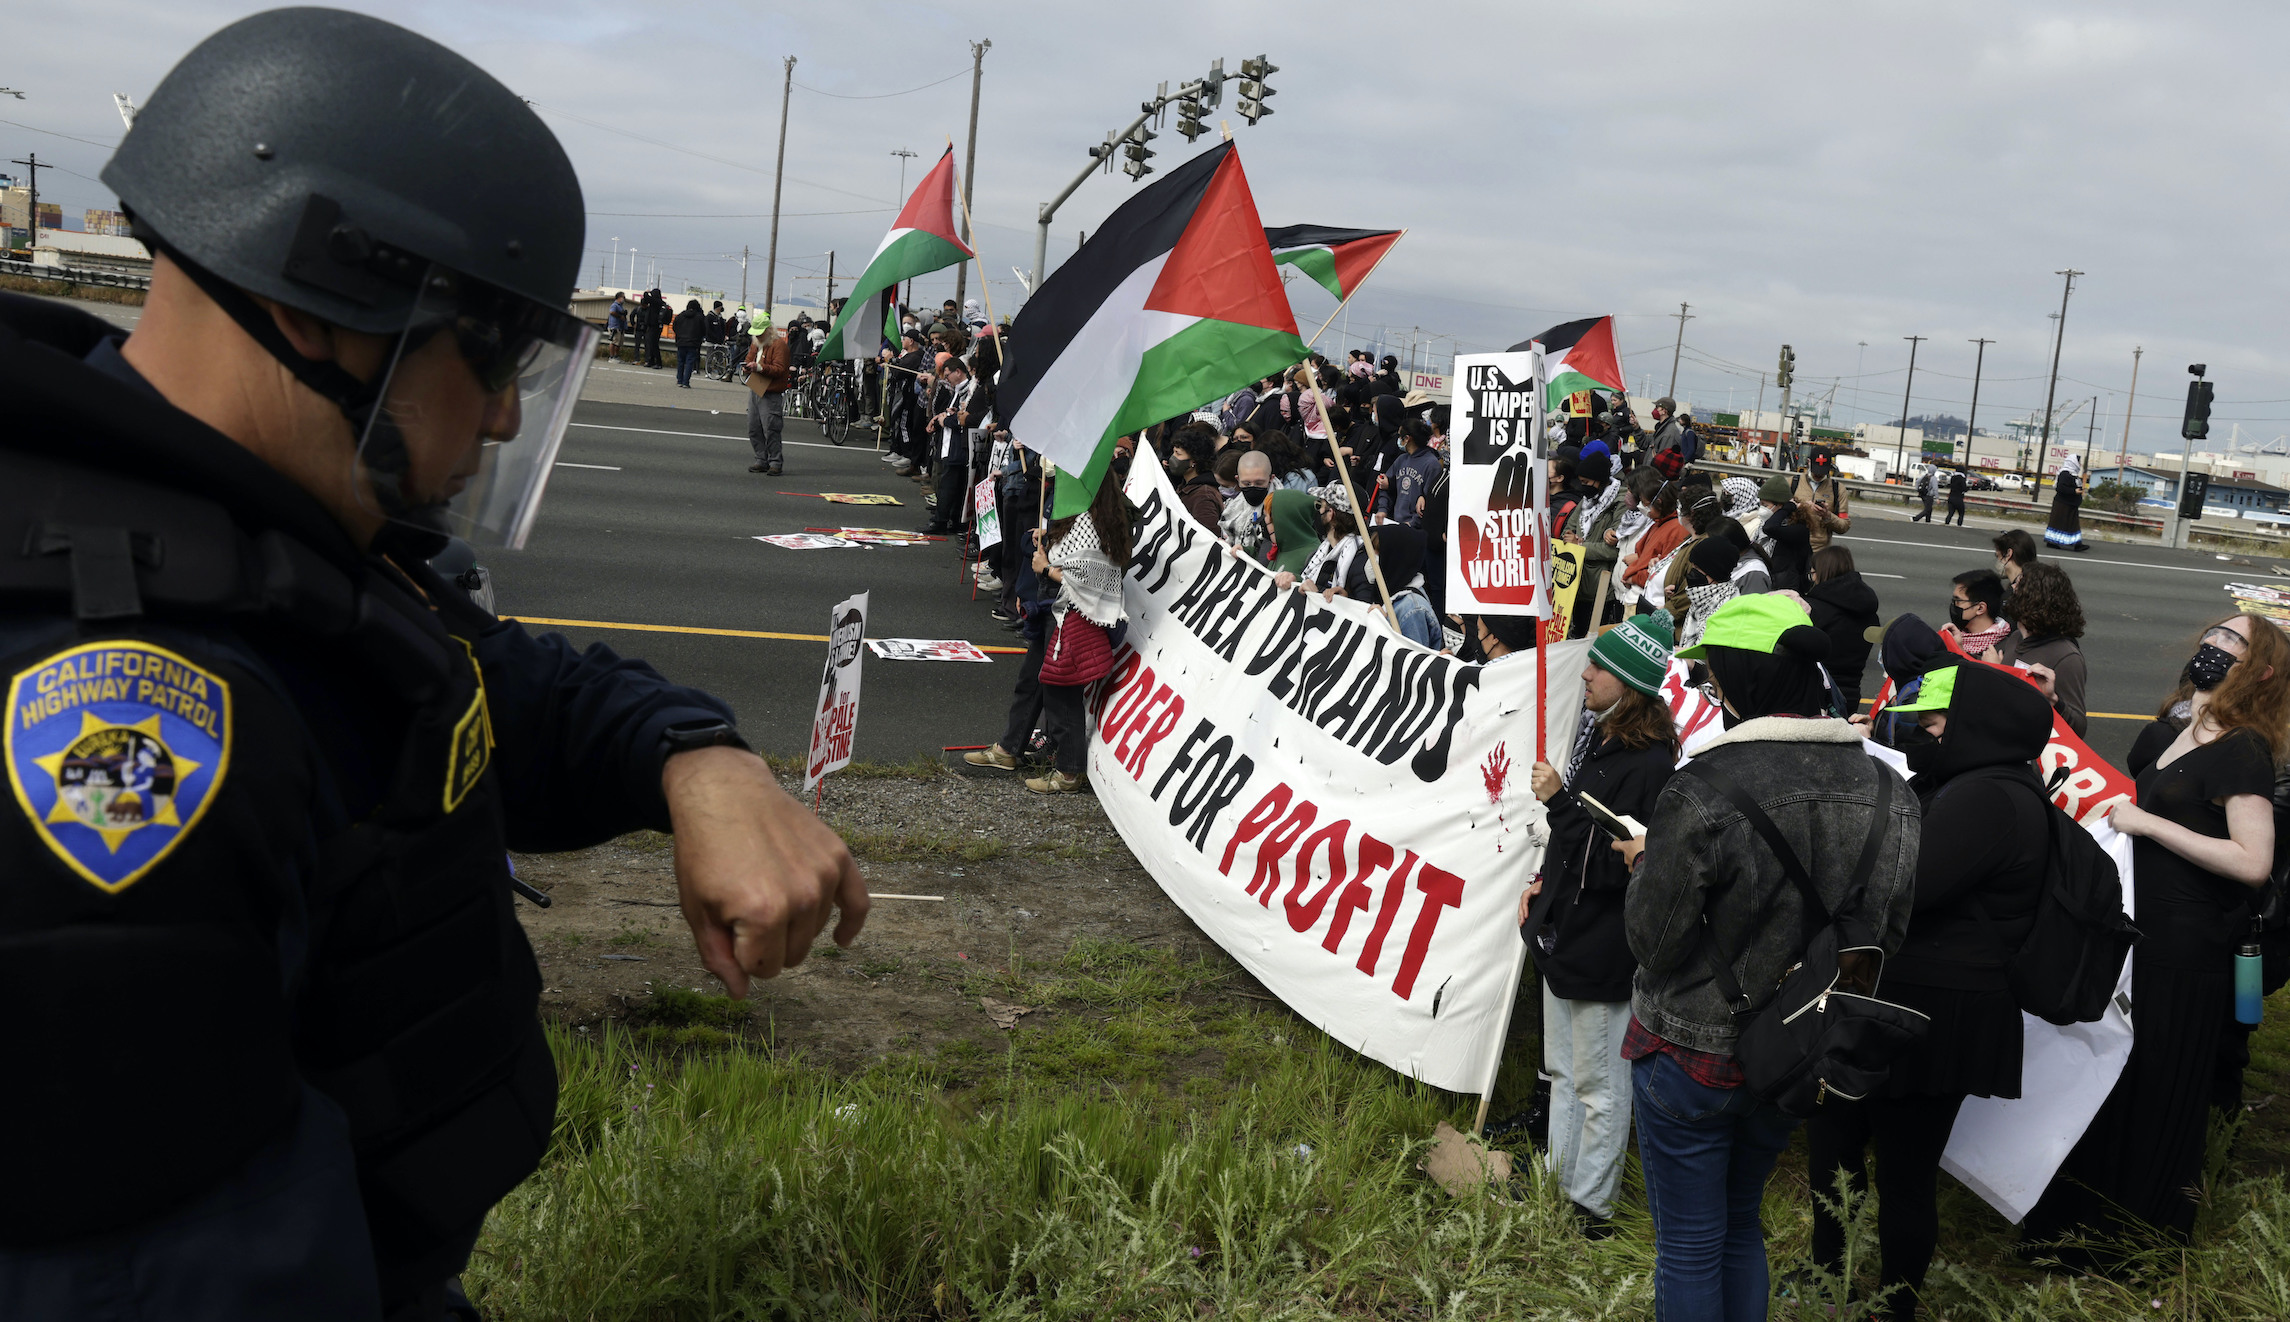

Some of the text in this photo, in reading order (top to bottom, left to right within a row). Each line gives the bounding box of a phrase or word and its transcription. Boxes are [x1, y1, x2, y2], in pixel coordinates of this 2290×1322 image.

[8, 262, 143, 289] VA PALESTI
[1415, 375, 1442, 389] ONE
[1470, 367, 1504, 391] U.S.
[1489, 419, 1527, 446] IS A
[1981, 457, 2000, 468] ONE
[2051, 447, 2069, 458] ONE
[1396, 466, 1424, 486] LAS VEGAS
[2048, 464, 2061, 474] ON
[1491, 537, 1521, 559] THE
[1468, 557, 1536, 589] WORLD
[1122, 487, 1480, 782] BAY AREA DEMANDS
[1617, 624, 1663, 659] ELAND
[36, 651, 208, 699] CALIFORNIA
[21, 680, 219, 738] HIGHWAY PATROL
[830, 702, 855, 735] PALE
[825, 730, 853, 765] STINE
[1084, 642, 1465, 1000] RDER FOR PROFIT
